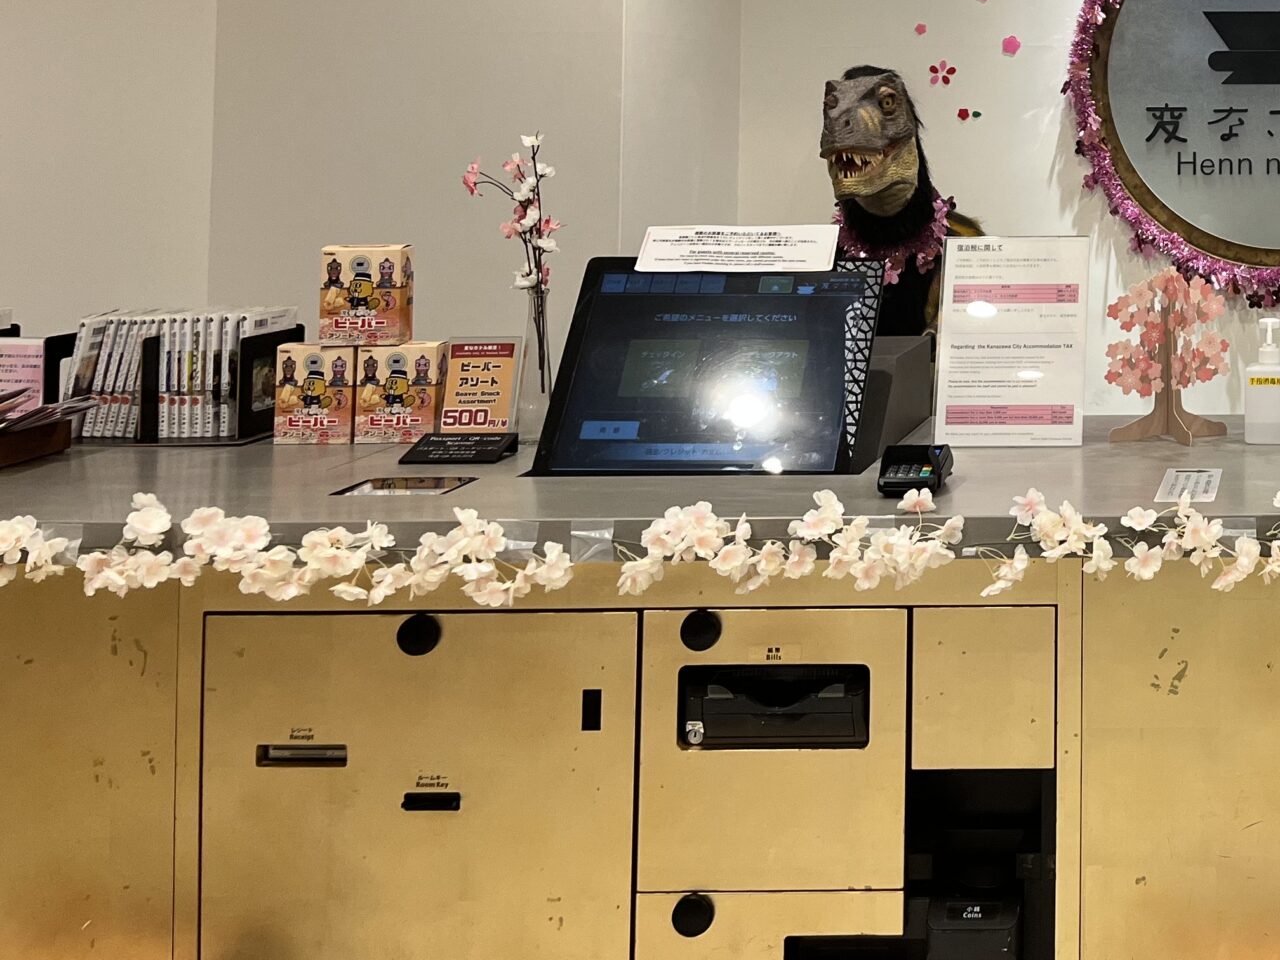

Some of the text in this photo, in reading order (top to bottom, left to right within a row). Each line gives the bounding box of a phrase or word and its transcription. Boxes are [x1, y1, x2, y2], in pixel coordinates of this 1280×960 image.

[1177, 151, 1253, 176] Henn
[333, 317, 386, 330] ビーバー
[654, 313, 798, 322] ご希望のメニューを選択してください
[460, 361, 502, 372] ビーバー
[458, 376, 499, 387] アソート
[287, 416, 338, 428] ビーバー
[368, 415, 421, 427] ビーバー
